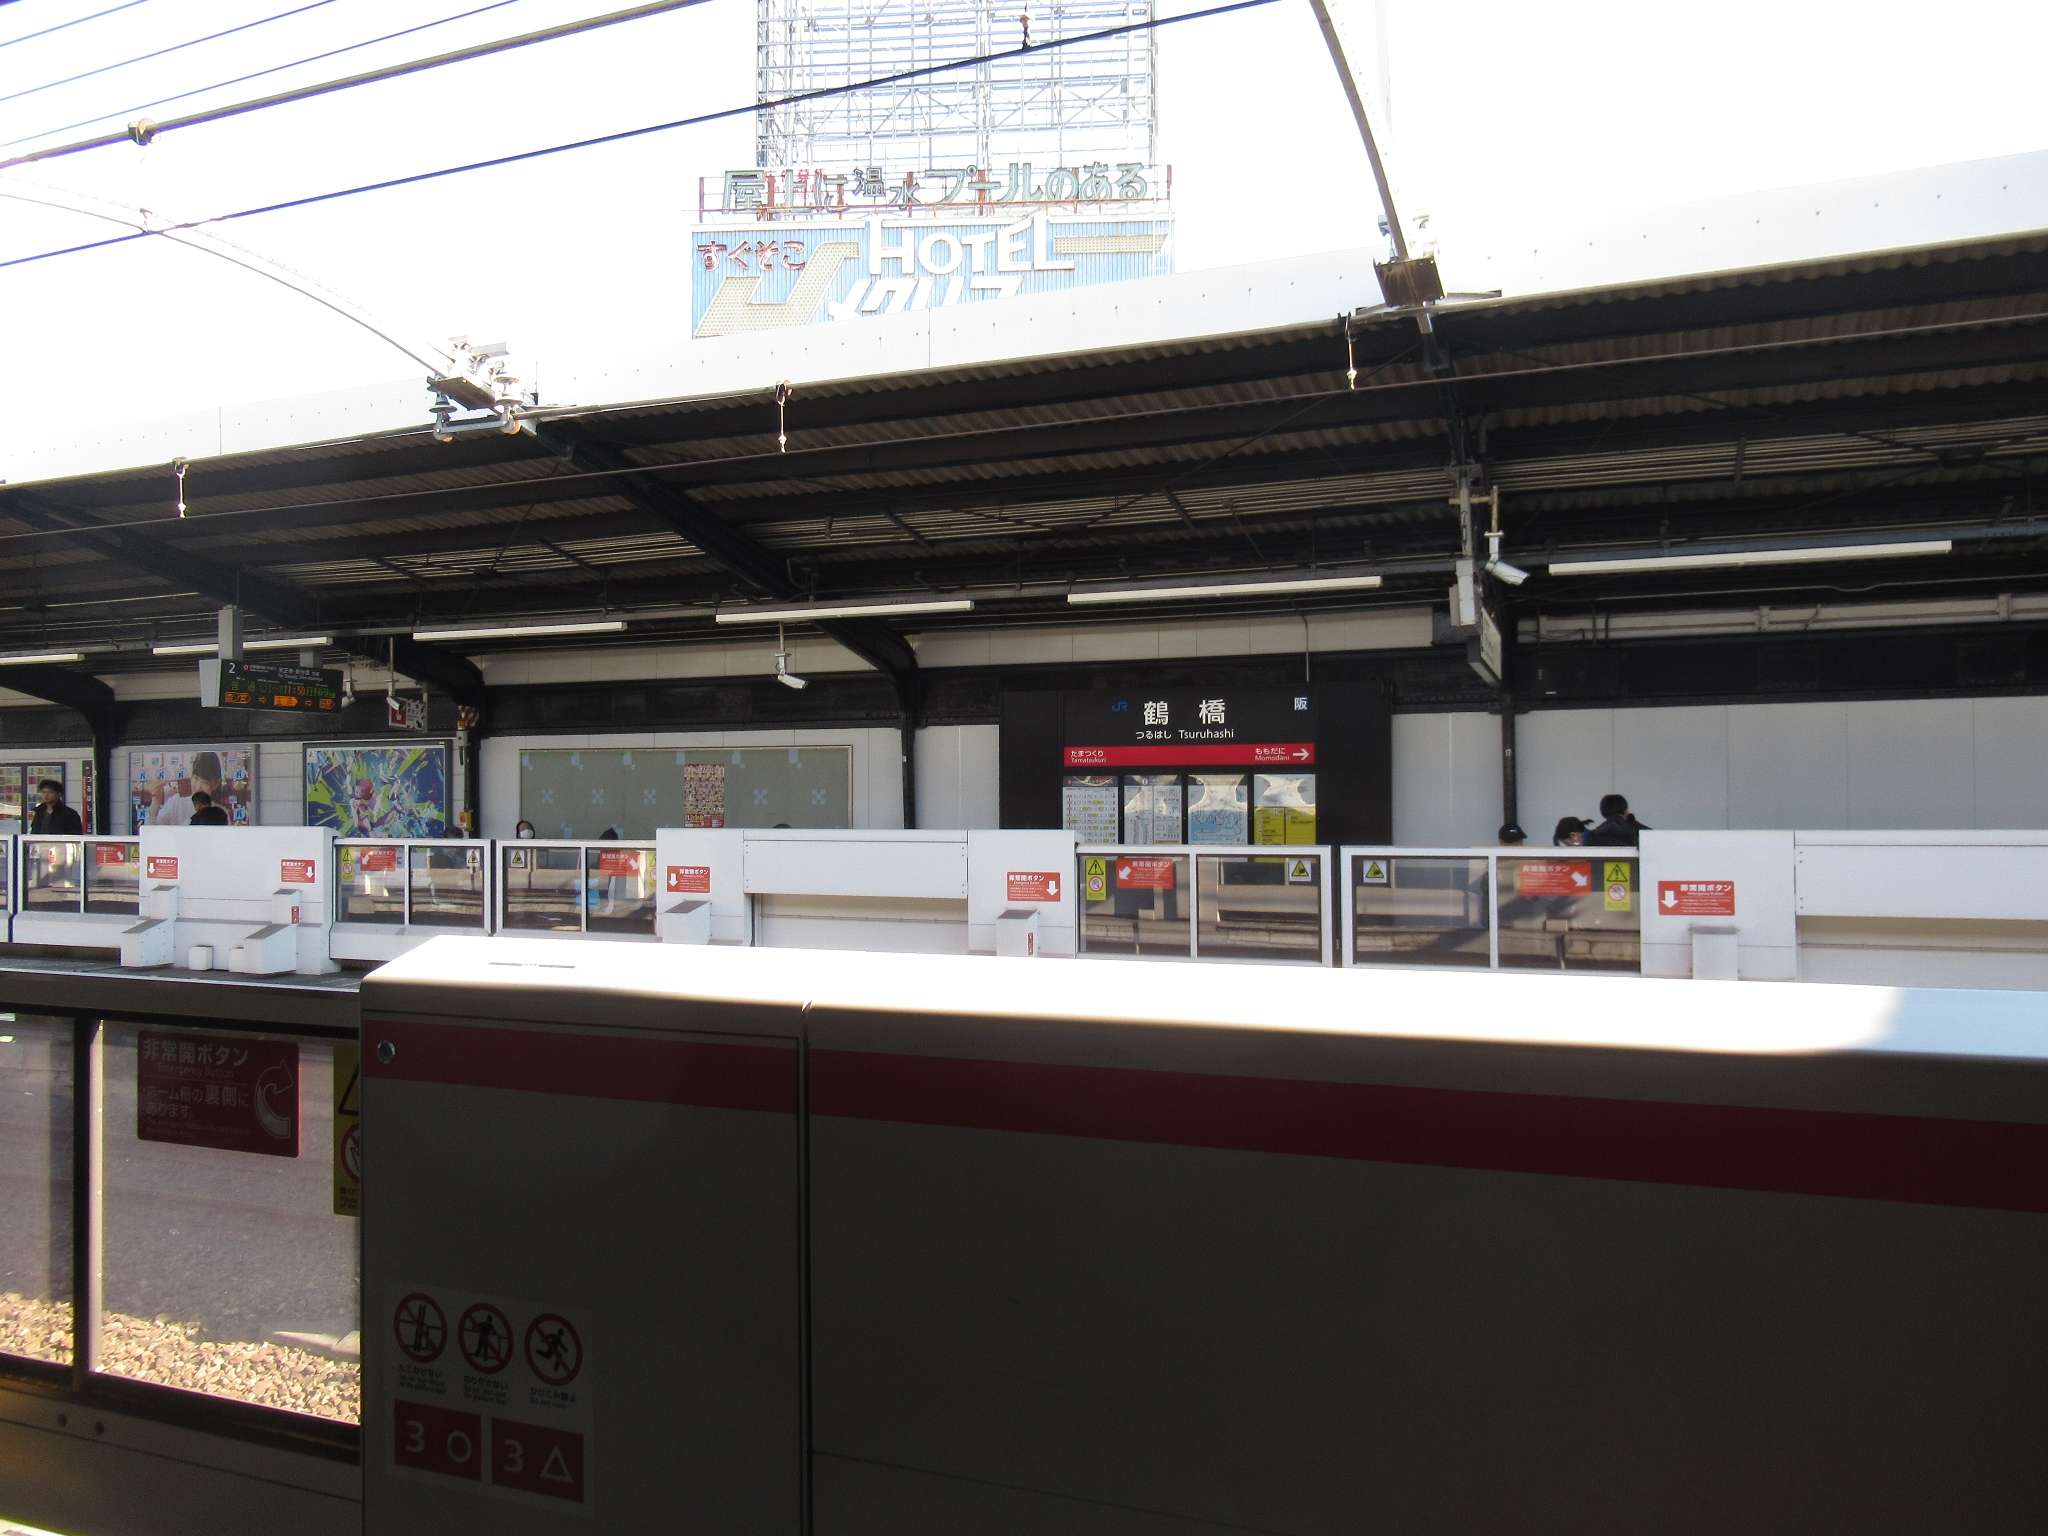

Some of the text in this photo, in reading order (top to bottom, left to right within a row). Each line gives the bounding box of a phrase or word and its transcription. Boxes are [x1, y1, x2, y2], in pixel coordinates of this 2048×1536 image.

[697, 240, 807, 272] すぐそこ
[867, 210, 1075, 276] HOTEL
[229, 662, 236, 674] 2
[1143, 698, 1226, 725] 鶴橋
[1294, 697, 1308, 711] 阪
[1135, 728, 1234, 739] つるはし Tsuruhashi
[143, 1039, 250, 1066] 非常開ボタン
[406, 1420, 425, 1453] 3
[503, 1439, 524, 1473] 3
